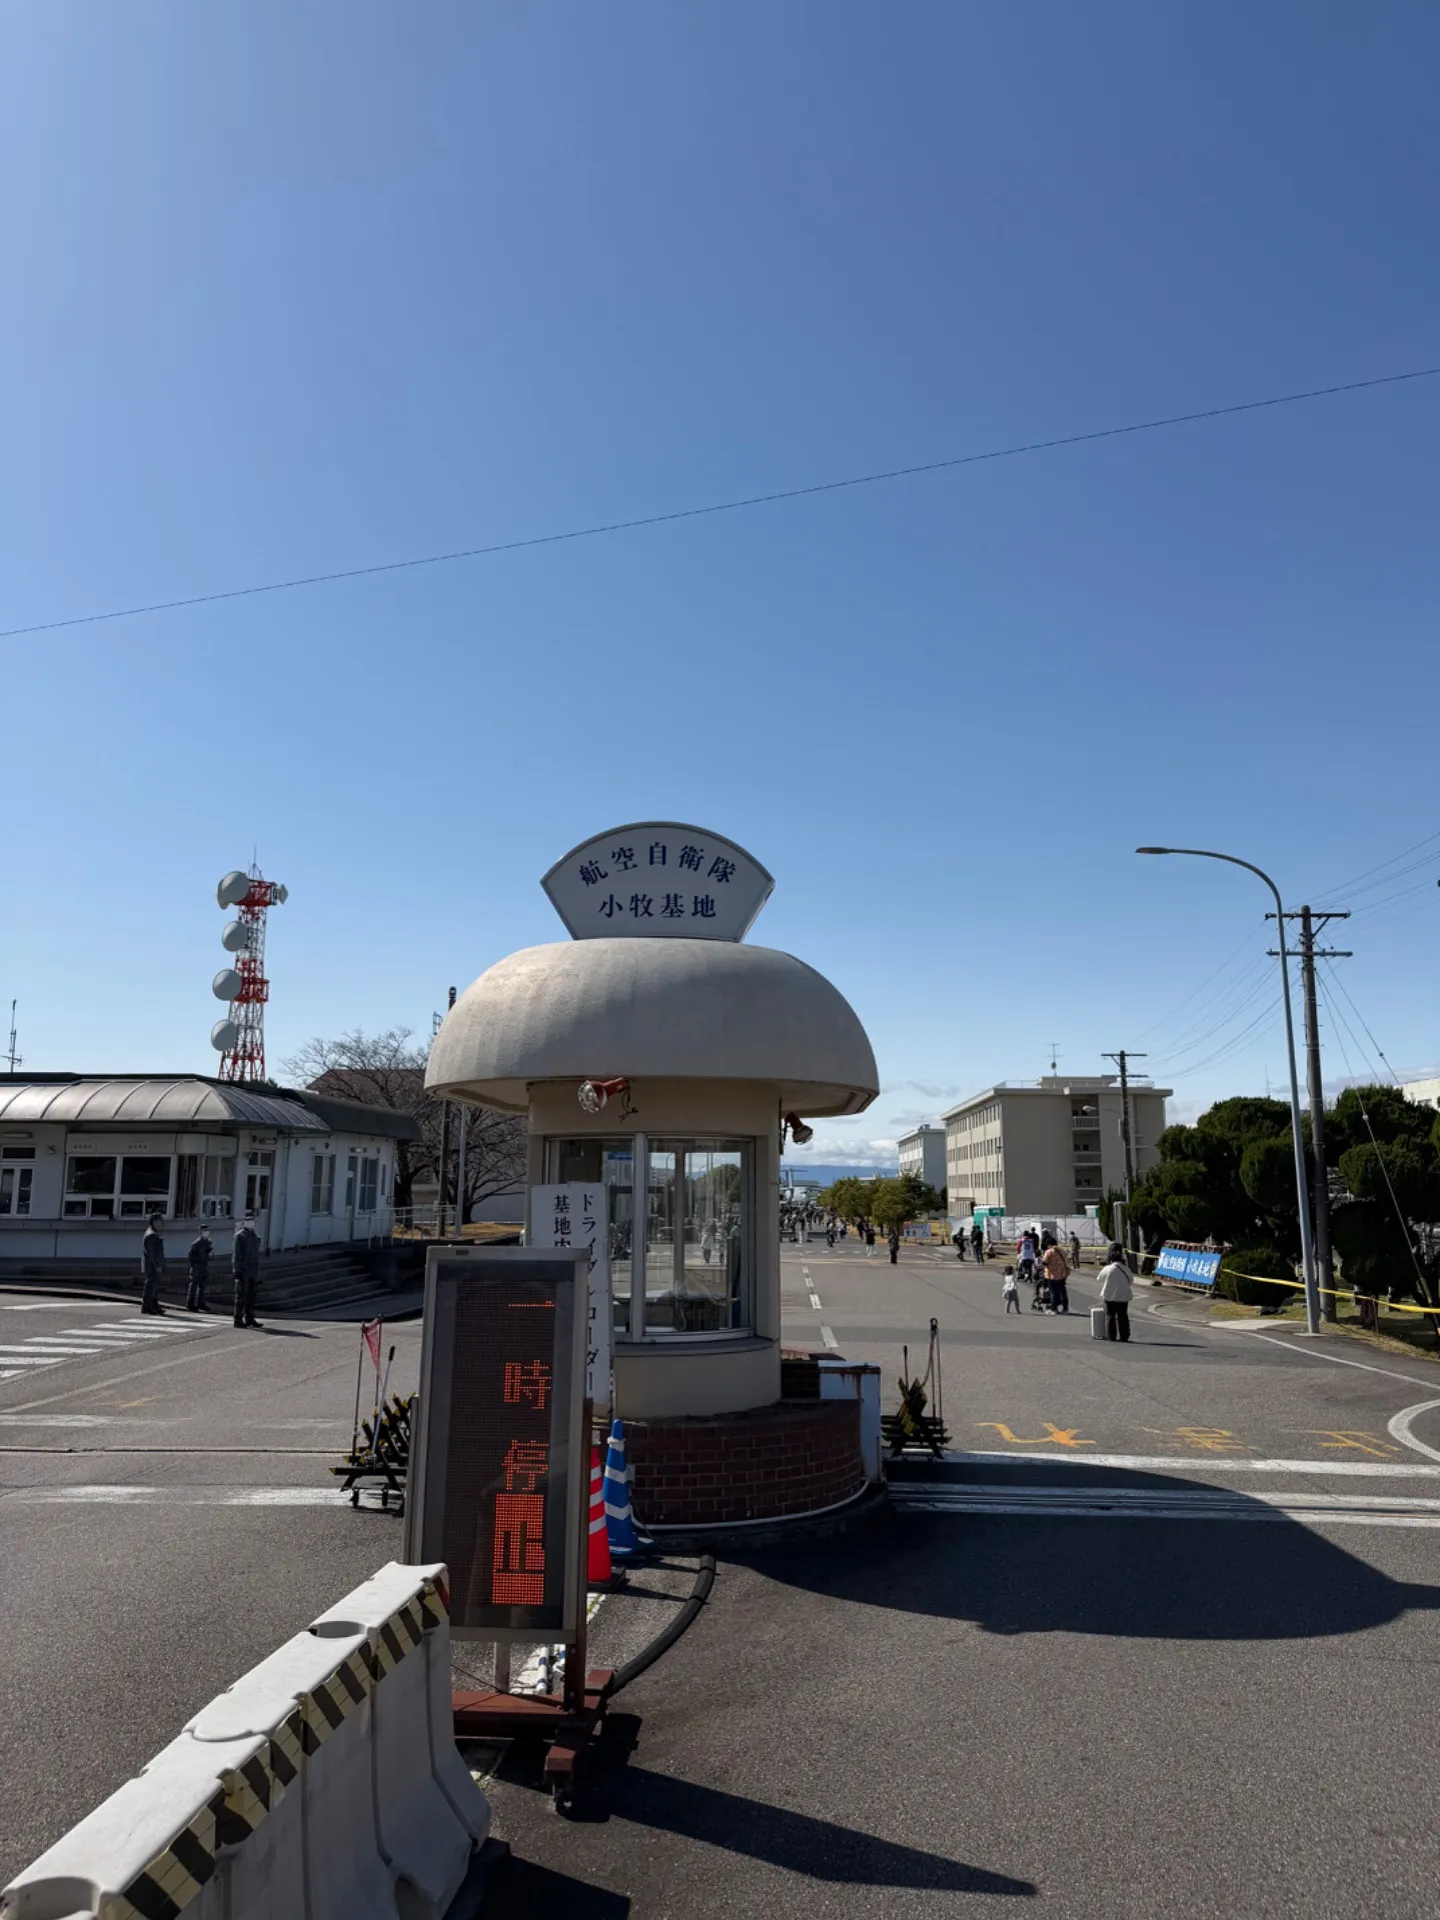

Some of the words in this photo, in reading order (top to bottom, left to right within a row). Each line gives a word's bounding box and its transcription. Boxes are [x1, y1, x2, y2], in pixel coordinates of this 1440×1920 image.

[578, 841, 737, 888] 航空自衛隊
[598, 893, 717, 919] 小牧基地
